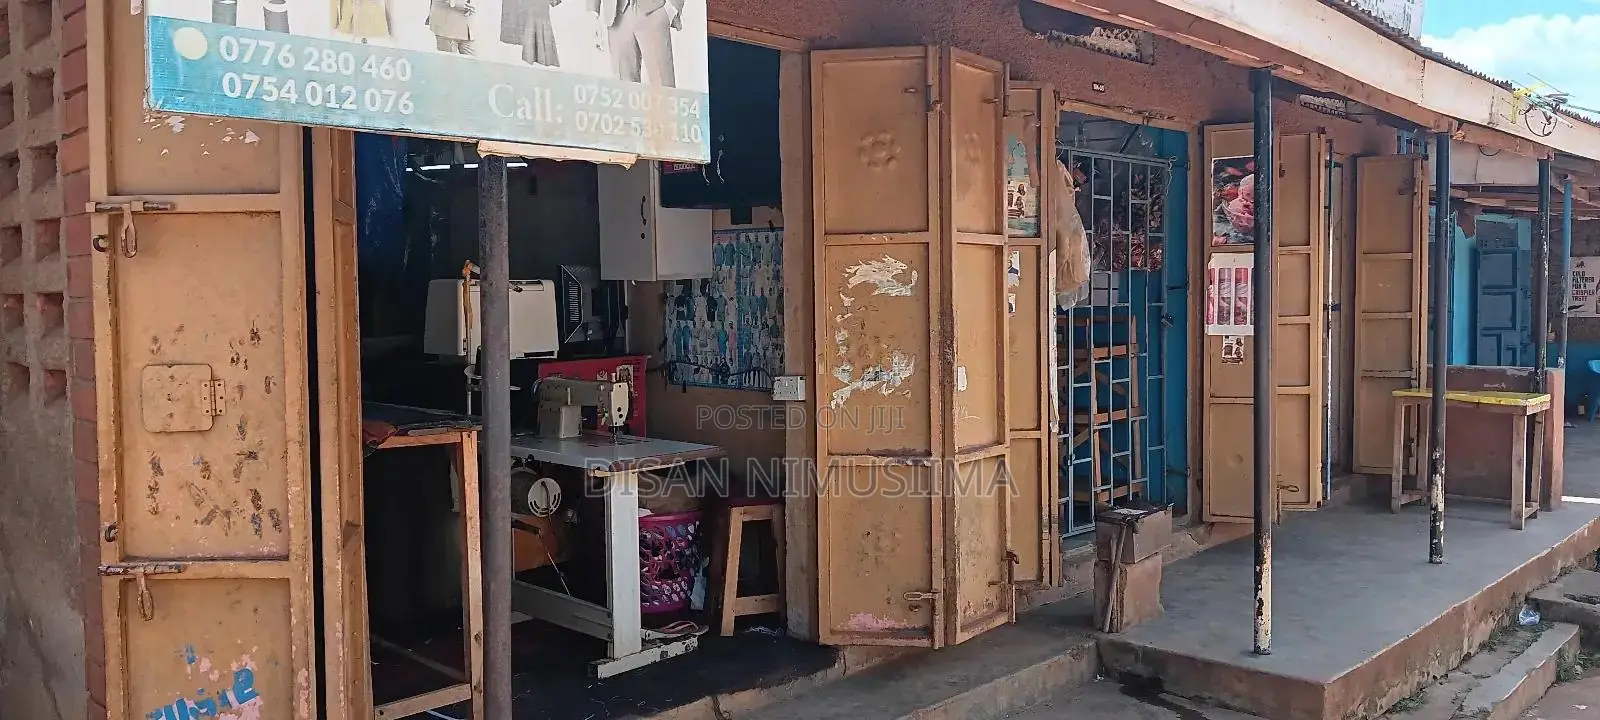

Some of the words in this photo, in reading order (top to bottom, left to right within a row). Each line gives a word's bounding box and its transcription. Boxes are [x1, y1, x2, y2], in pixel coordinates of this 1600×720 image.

[219, 35, 296, 69] 0776
[303, 47, 356, 76] 280
[362, 54, 412, 82] 460
[222, 72, 298, 105] 0754
[305, 81, 358, 111] 012
[364, 88, 415, 115] 076
[488, 84, 563, 124] Call:
[573, 83, 624, 109] 0752
[628, 91, 661, 112] 007
[668, 96, 701, 119] 354
[575, 110, 627, 135] 0702
[671, 120, 702, 143] 110
